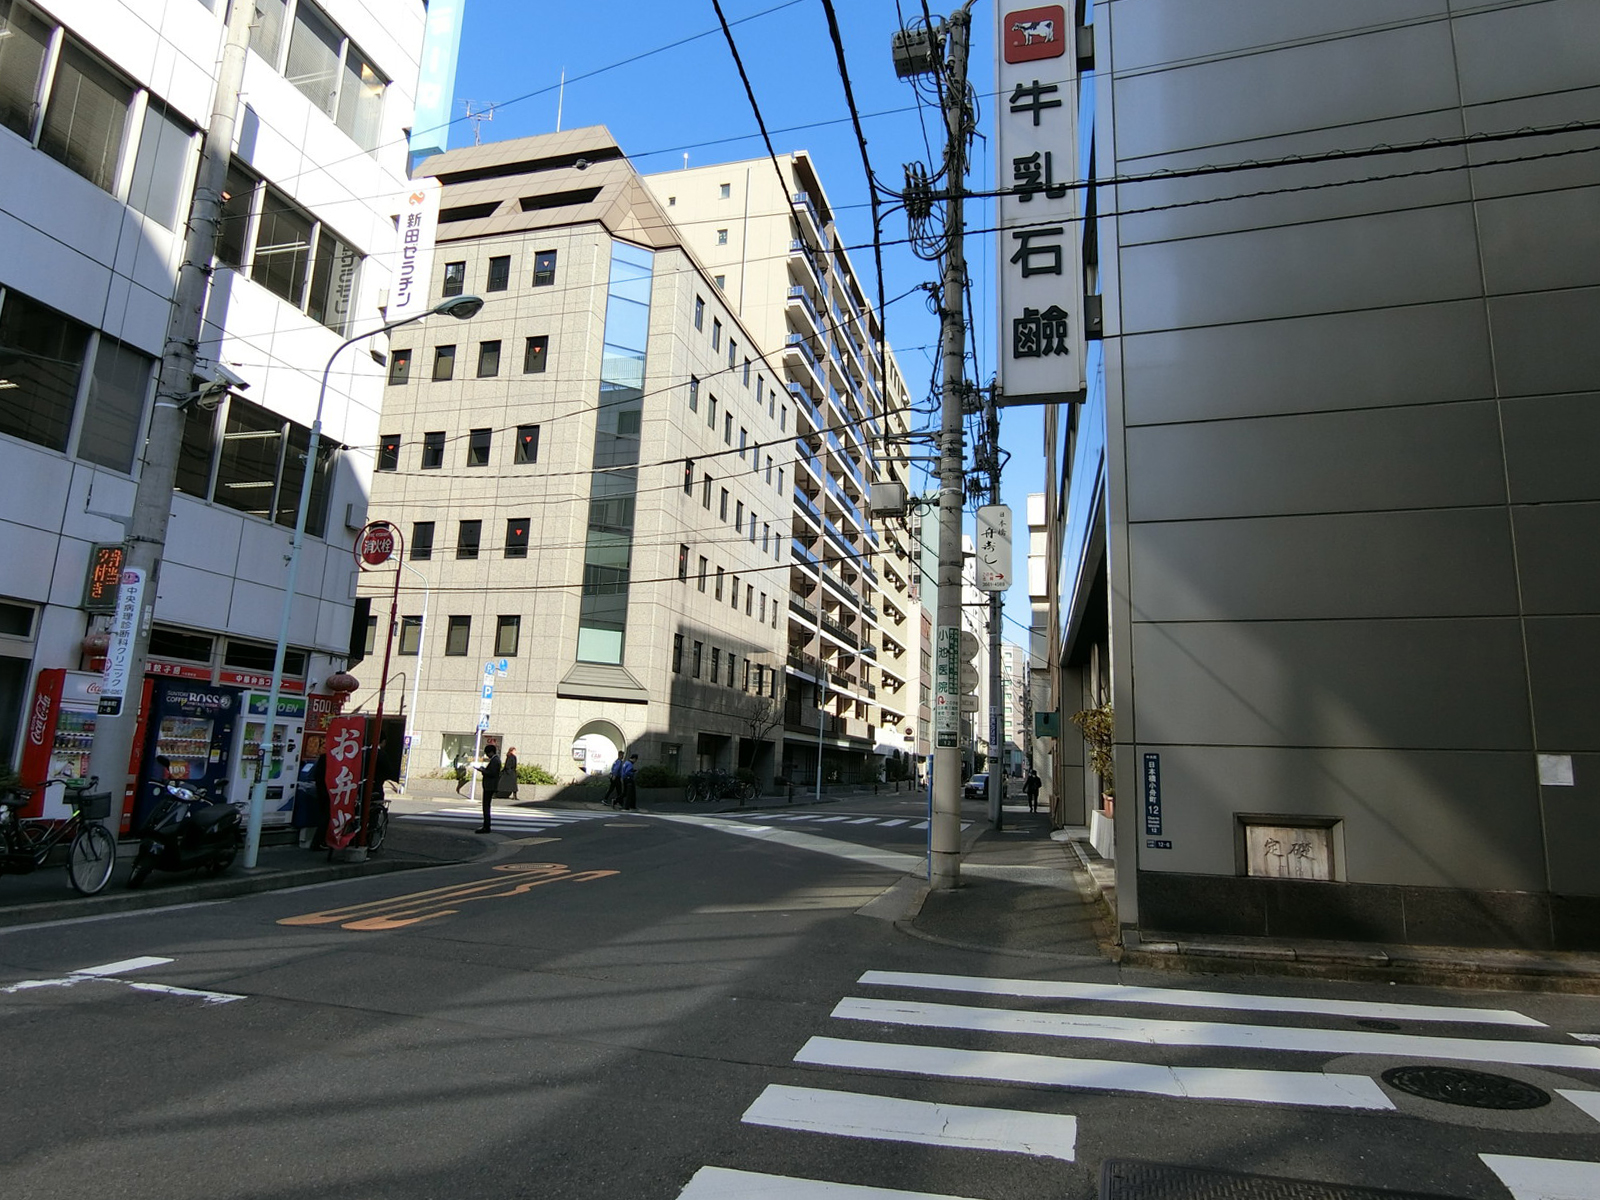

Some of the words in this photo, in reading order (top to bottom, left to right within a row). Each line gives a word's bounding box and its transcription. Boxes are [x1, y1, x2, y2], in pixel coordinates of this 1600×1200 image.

[396, 212, 423, 308] 新田ゼラチン
[998, 512, 1007, 536] 日本橋
[363, 538, 392, 554] 消火栓
[112, 586, 138, 687] 中央病理診断科クリニック
[937, 629, 949, 693] 小池医院
[235, 674, 290, 687] 中華弁当コー
[189, 692, 219, 704] BOSS
[31, 693, 51, 745] Coca-Cola
[1148, 761, 1157, 803] 日本橋小舟町
[1148, 805, 1159, 815] 12
